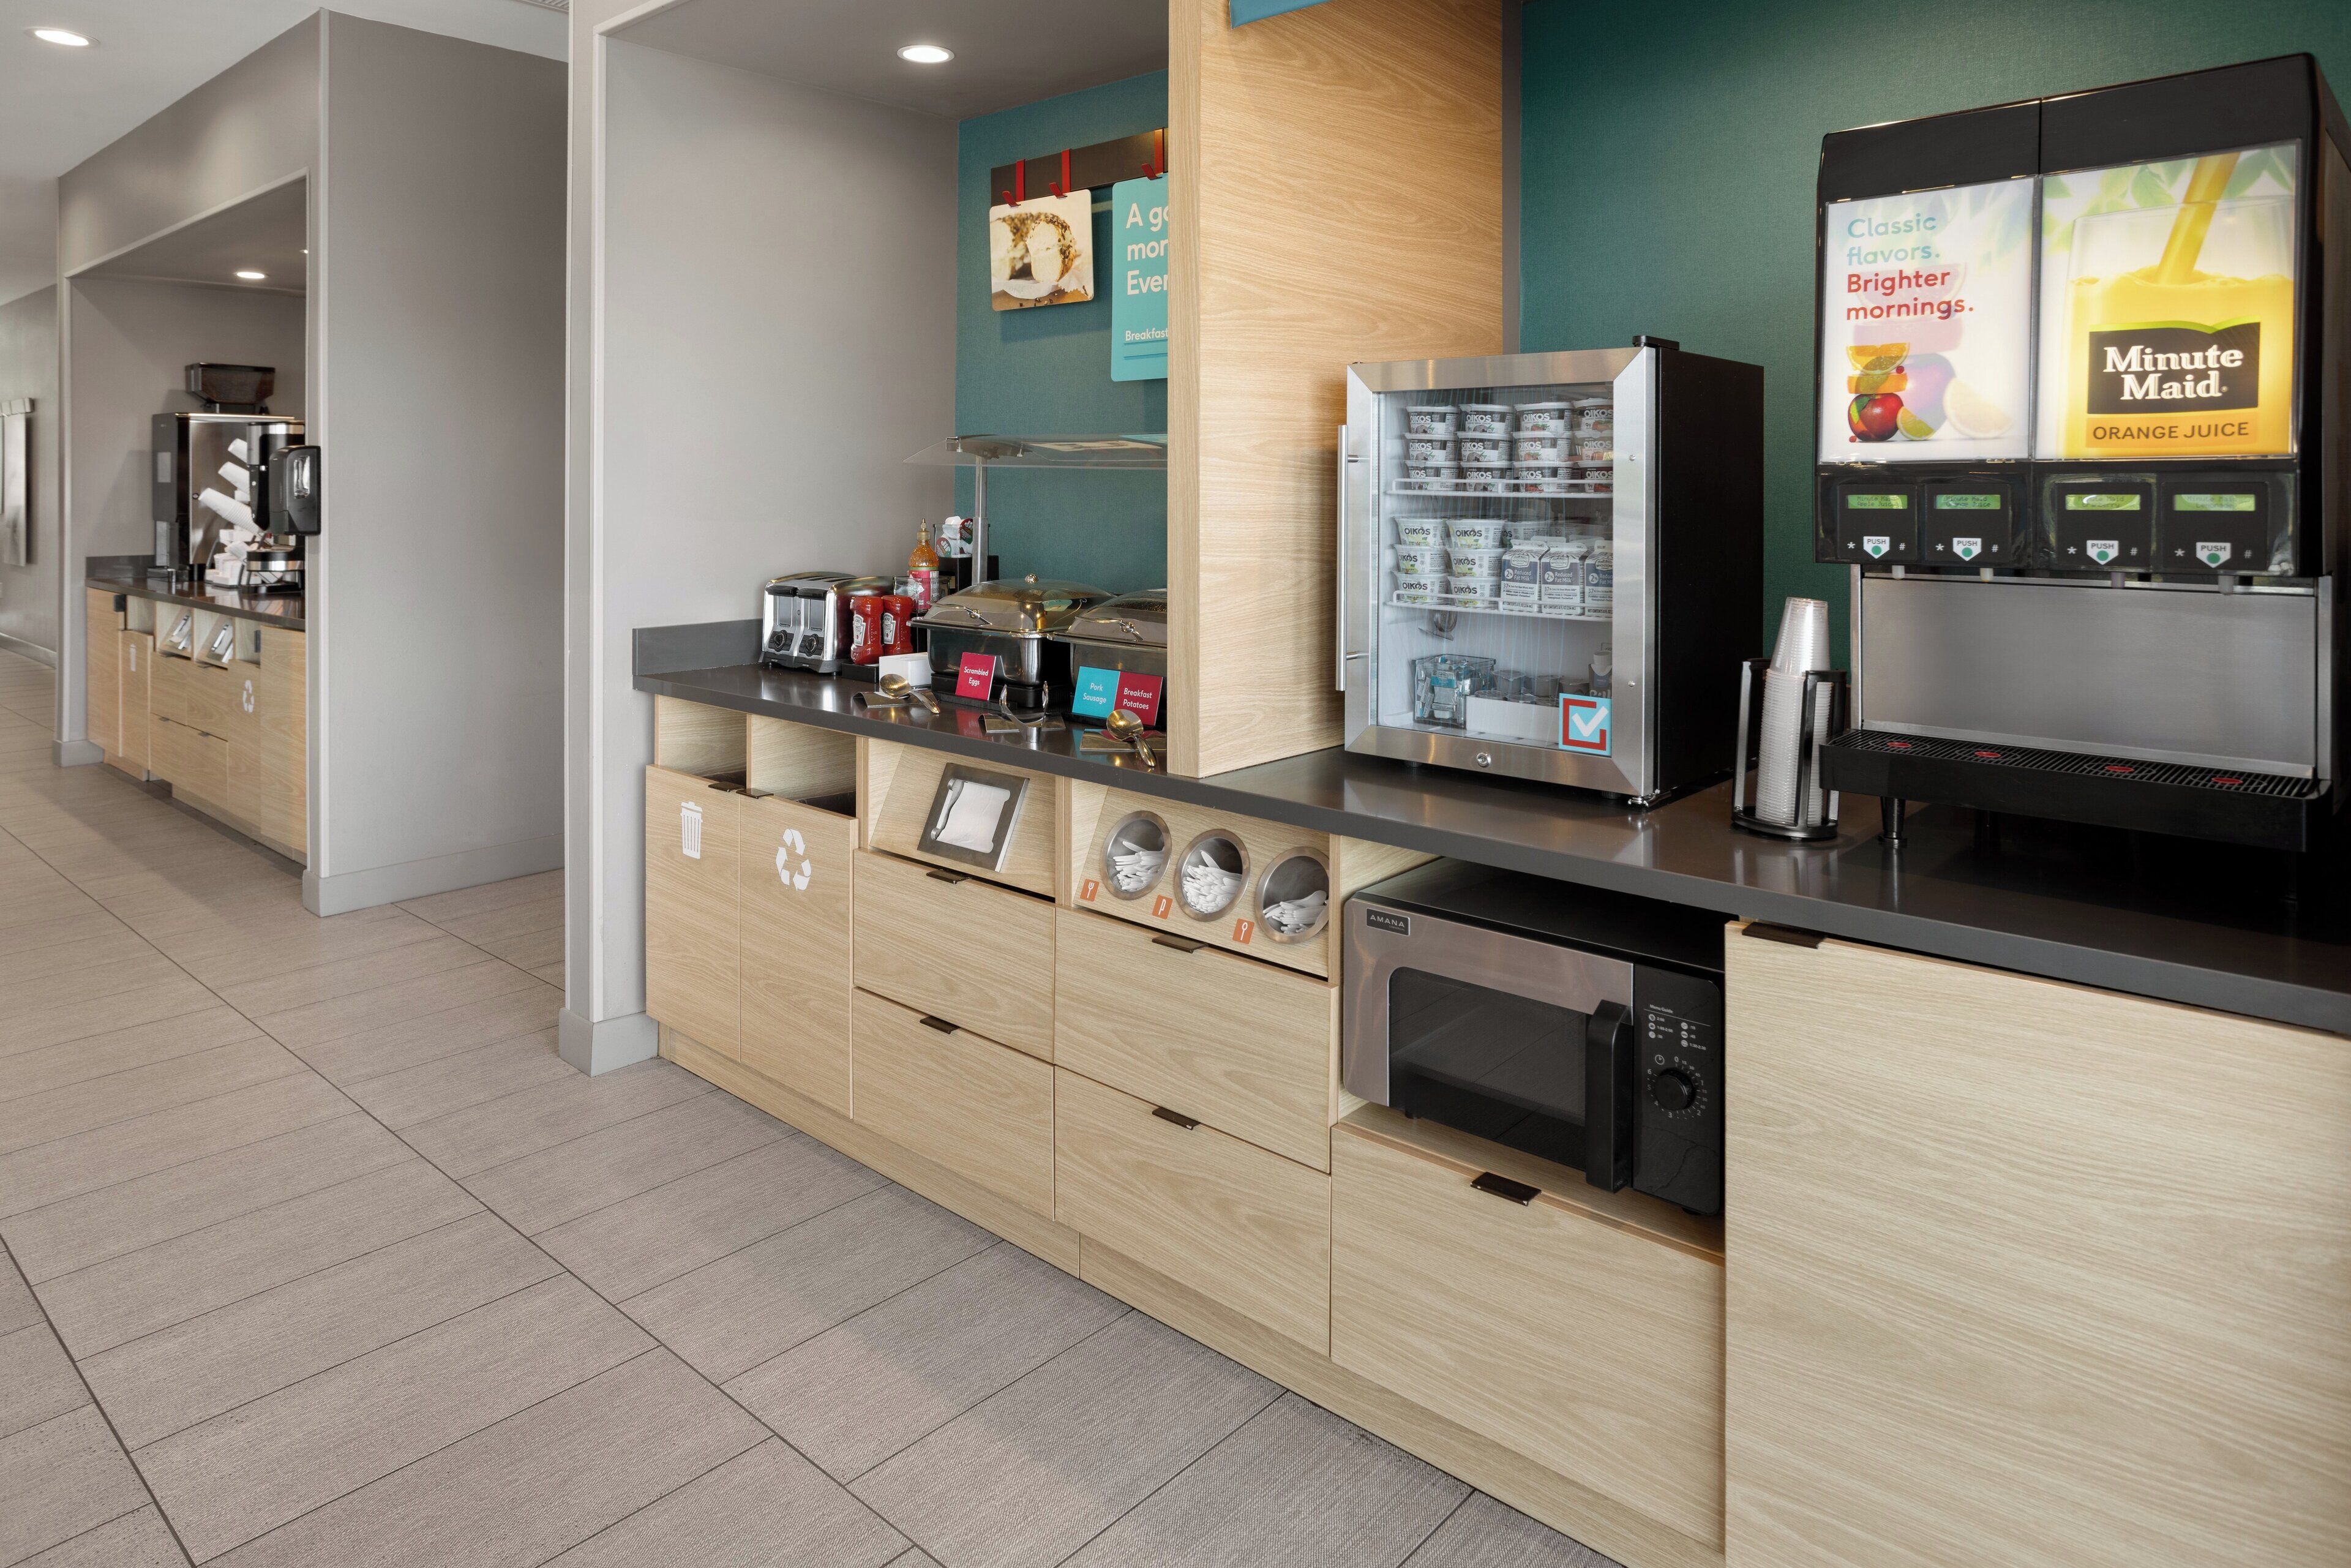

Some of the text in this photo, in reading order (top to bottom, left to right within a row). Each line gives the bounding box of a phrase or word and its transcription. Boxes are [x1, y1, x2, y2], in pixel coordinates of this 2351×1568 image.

[1126, 203, 1144, 228] A
[1848, 213, 1937, 238] Classic
[1847, 246, 1940, 266] flavors.
[1848, 269, 1951, 296] Brighter
[1847, 297, 1974, 320] mornings.
[2103, 344, 2244, 372] Minute
[2120, 370, 2223, 400] Maid
[1523, 413, 1550, 422] OIKOS
[2093, 422, 2249, 440] ORANGE JUICE
[964, 666, 989, 676] Scrambled
[969, 677, 980, 686] Eggs
[1090, 683, 1103, 691] Pork
[1082, 692, 1106, 704] Sausage
[1123, 688, 1153, 699] Breakfast
[1123, 699, 1149, 710] Potatoes
[1370, 915, 1405, 928] AMANA
